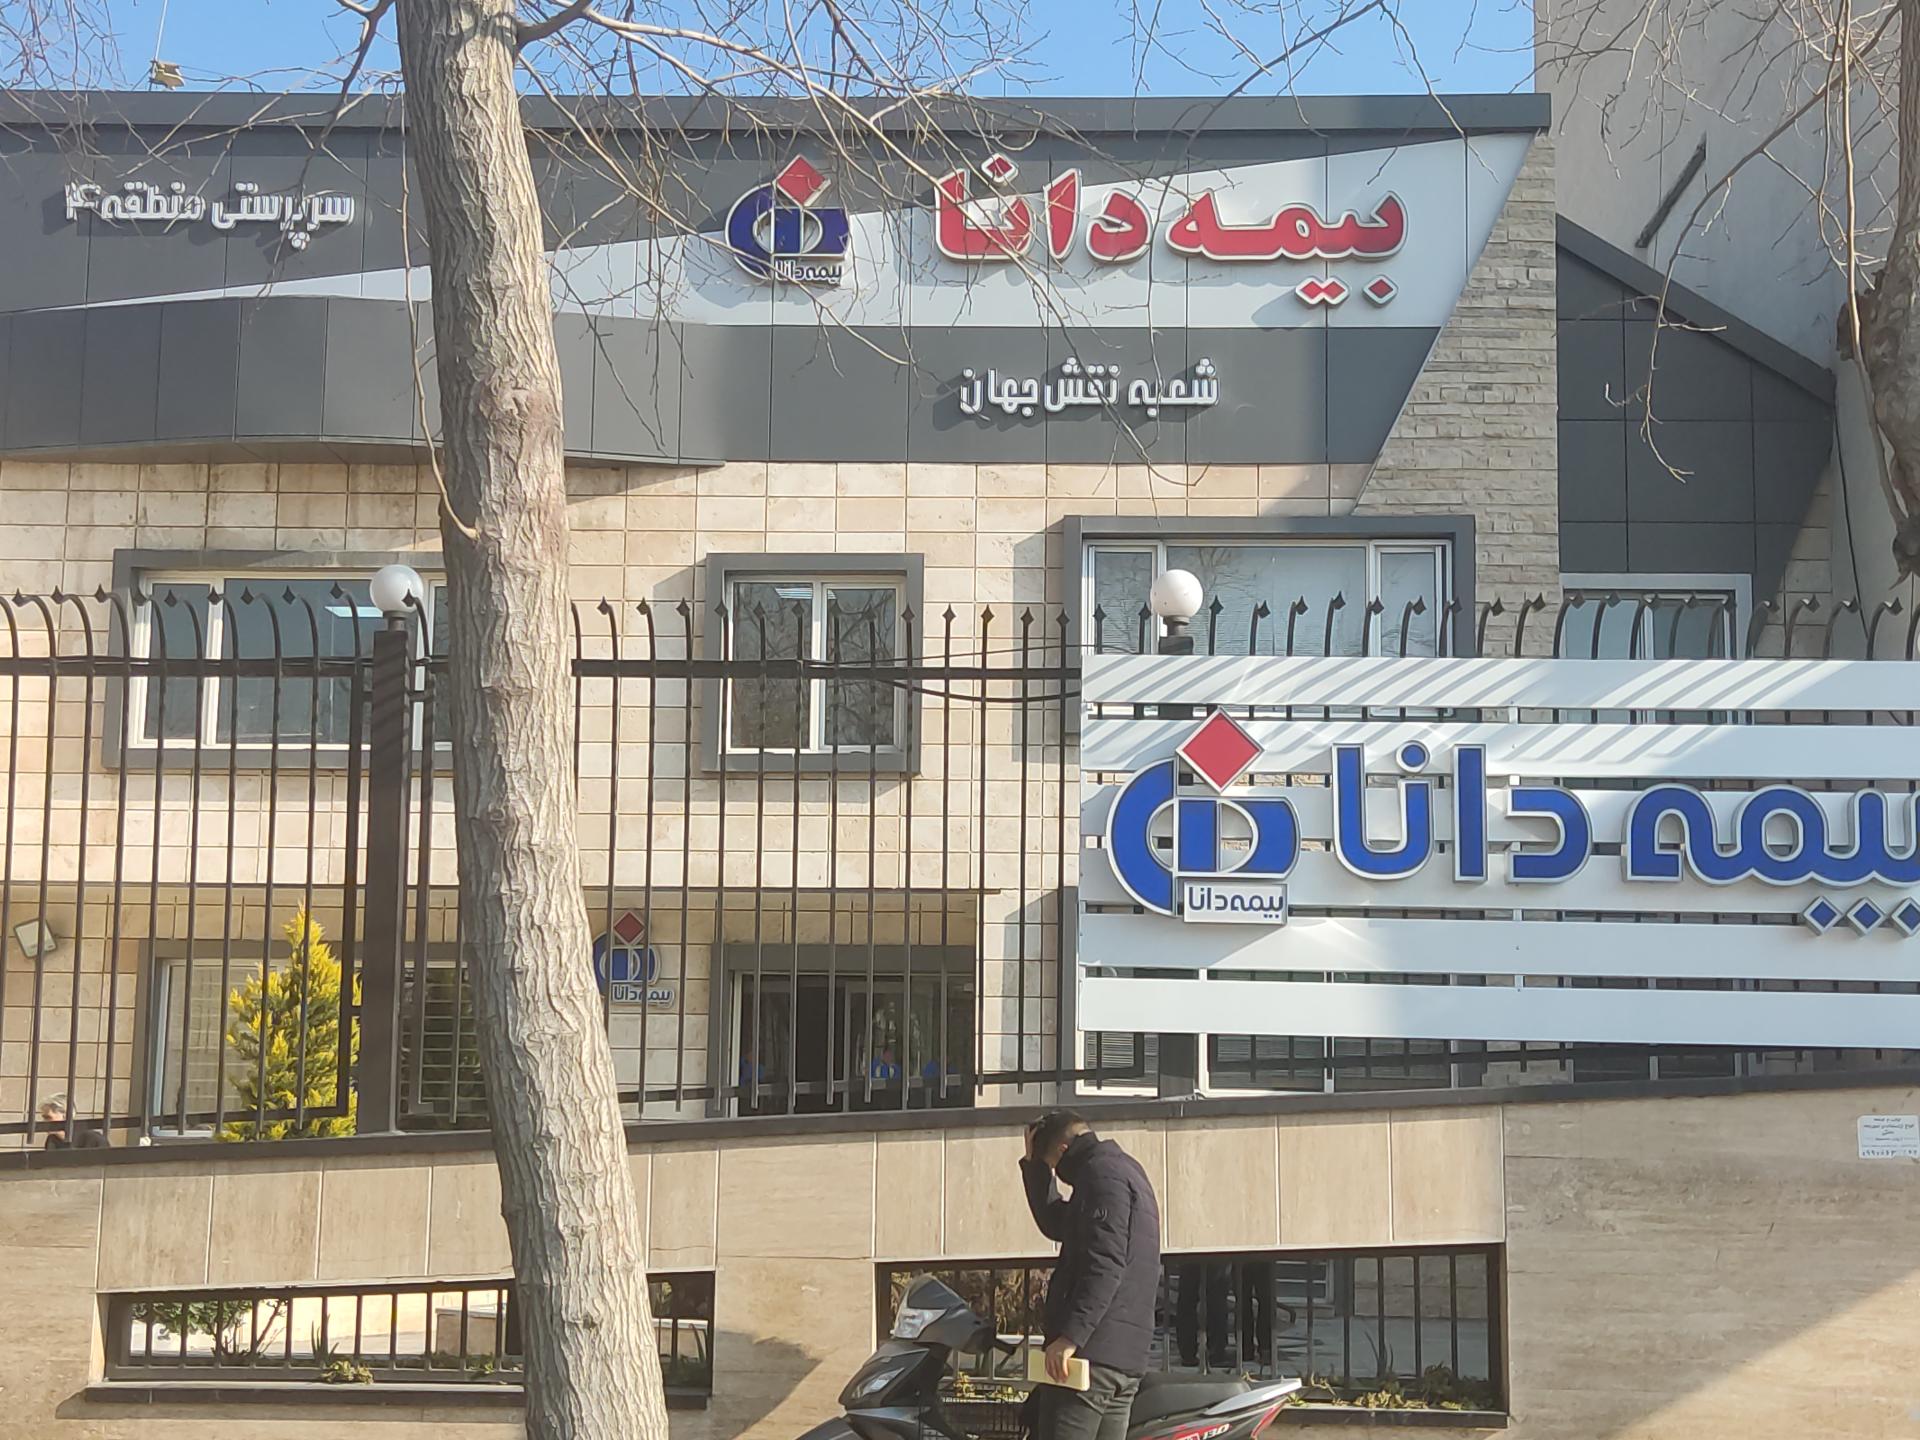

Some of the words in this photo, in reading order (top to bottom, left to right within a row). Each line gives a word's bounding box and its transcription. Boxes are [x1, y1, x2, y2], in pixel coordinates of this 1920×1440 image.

[101, 180, 206, 222] منطقه
[210, 181, 356, 251] سرپرستی
[934, 152, 1153, 263] دانا
[1164, 188, 1409, 306] بیمه
[959, 366, 1039, 418] جهان
[1043, 355, 1120, 412] نقش
[1127, 356, 1220, 418] شعبه
[1331, 740, 1592, 885] دانا
[1188, 886, 1228, 911] دانا
[1230, 894, 1284, 919] بیمه
